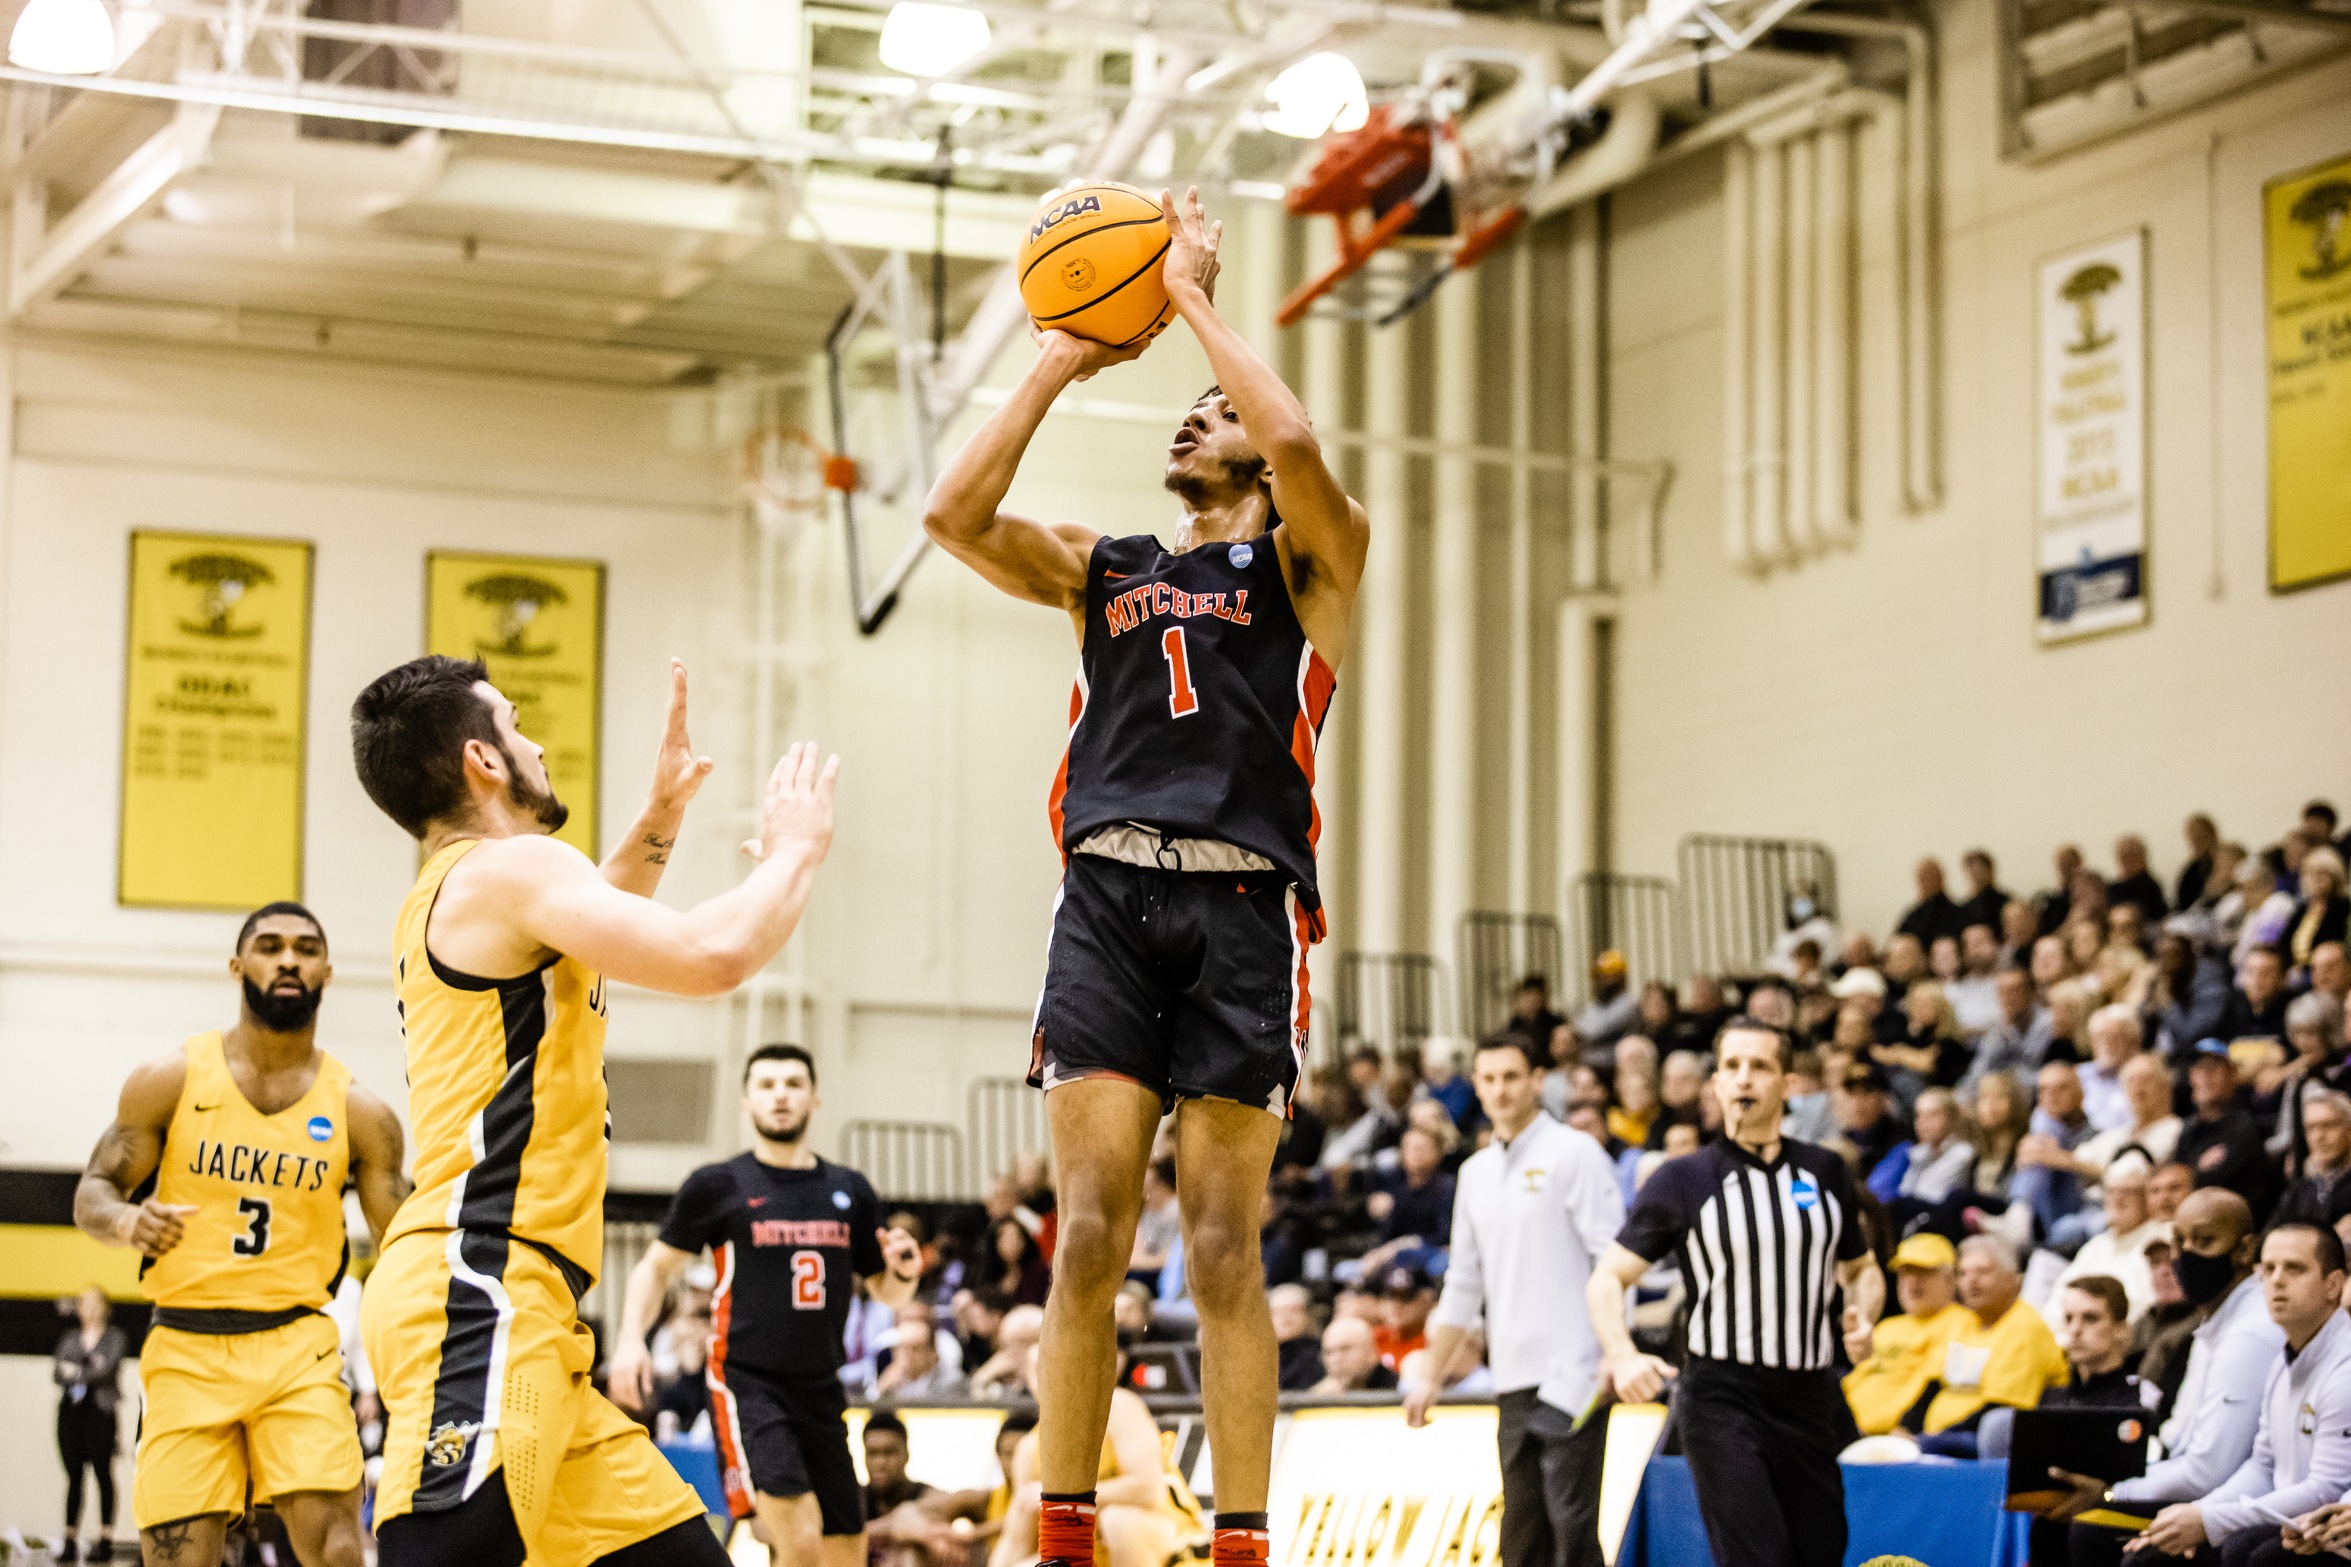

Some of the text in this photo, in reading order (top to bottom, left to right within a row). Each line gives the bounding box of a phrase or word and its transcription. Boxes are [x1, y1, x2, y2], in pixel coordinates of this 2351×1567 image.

[1029, 196, 1101, 245] NCAA
[1232, 553, 1253, 564] NCAA
[1105, 582, 1252, 638] MITCHELL
[1161, 625, 1199, 720] 1
[189, 1140, 329, 1192] JACKETS
[232, 1197, 272, 1258] 3
[790, 1250, 826, 1310] 2
[1285, 1492, 1505, 1567] YELLOW JAC
